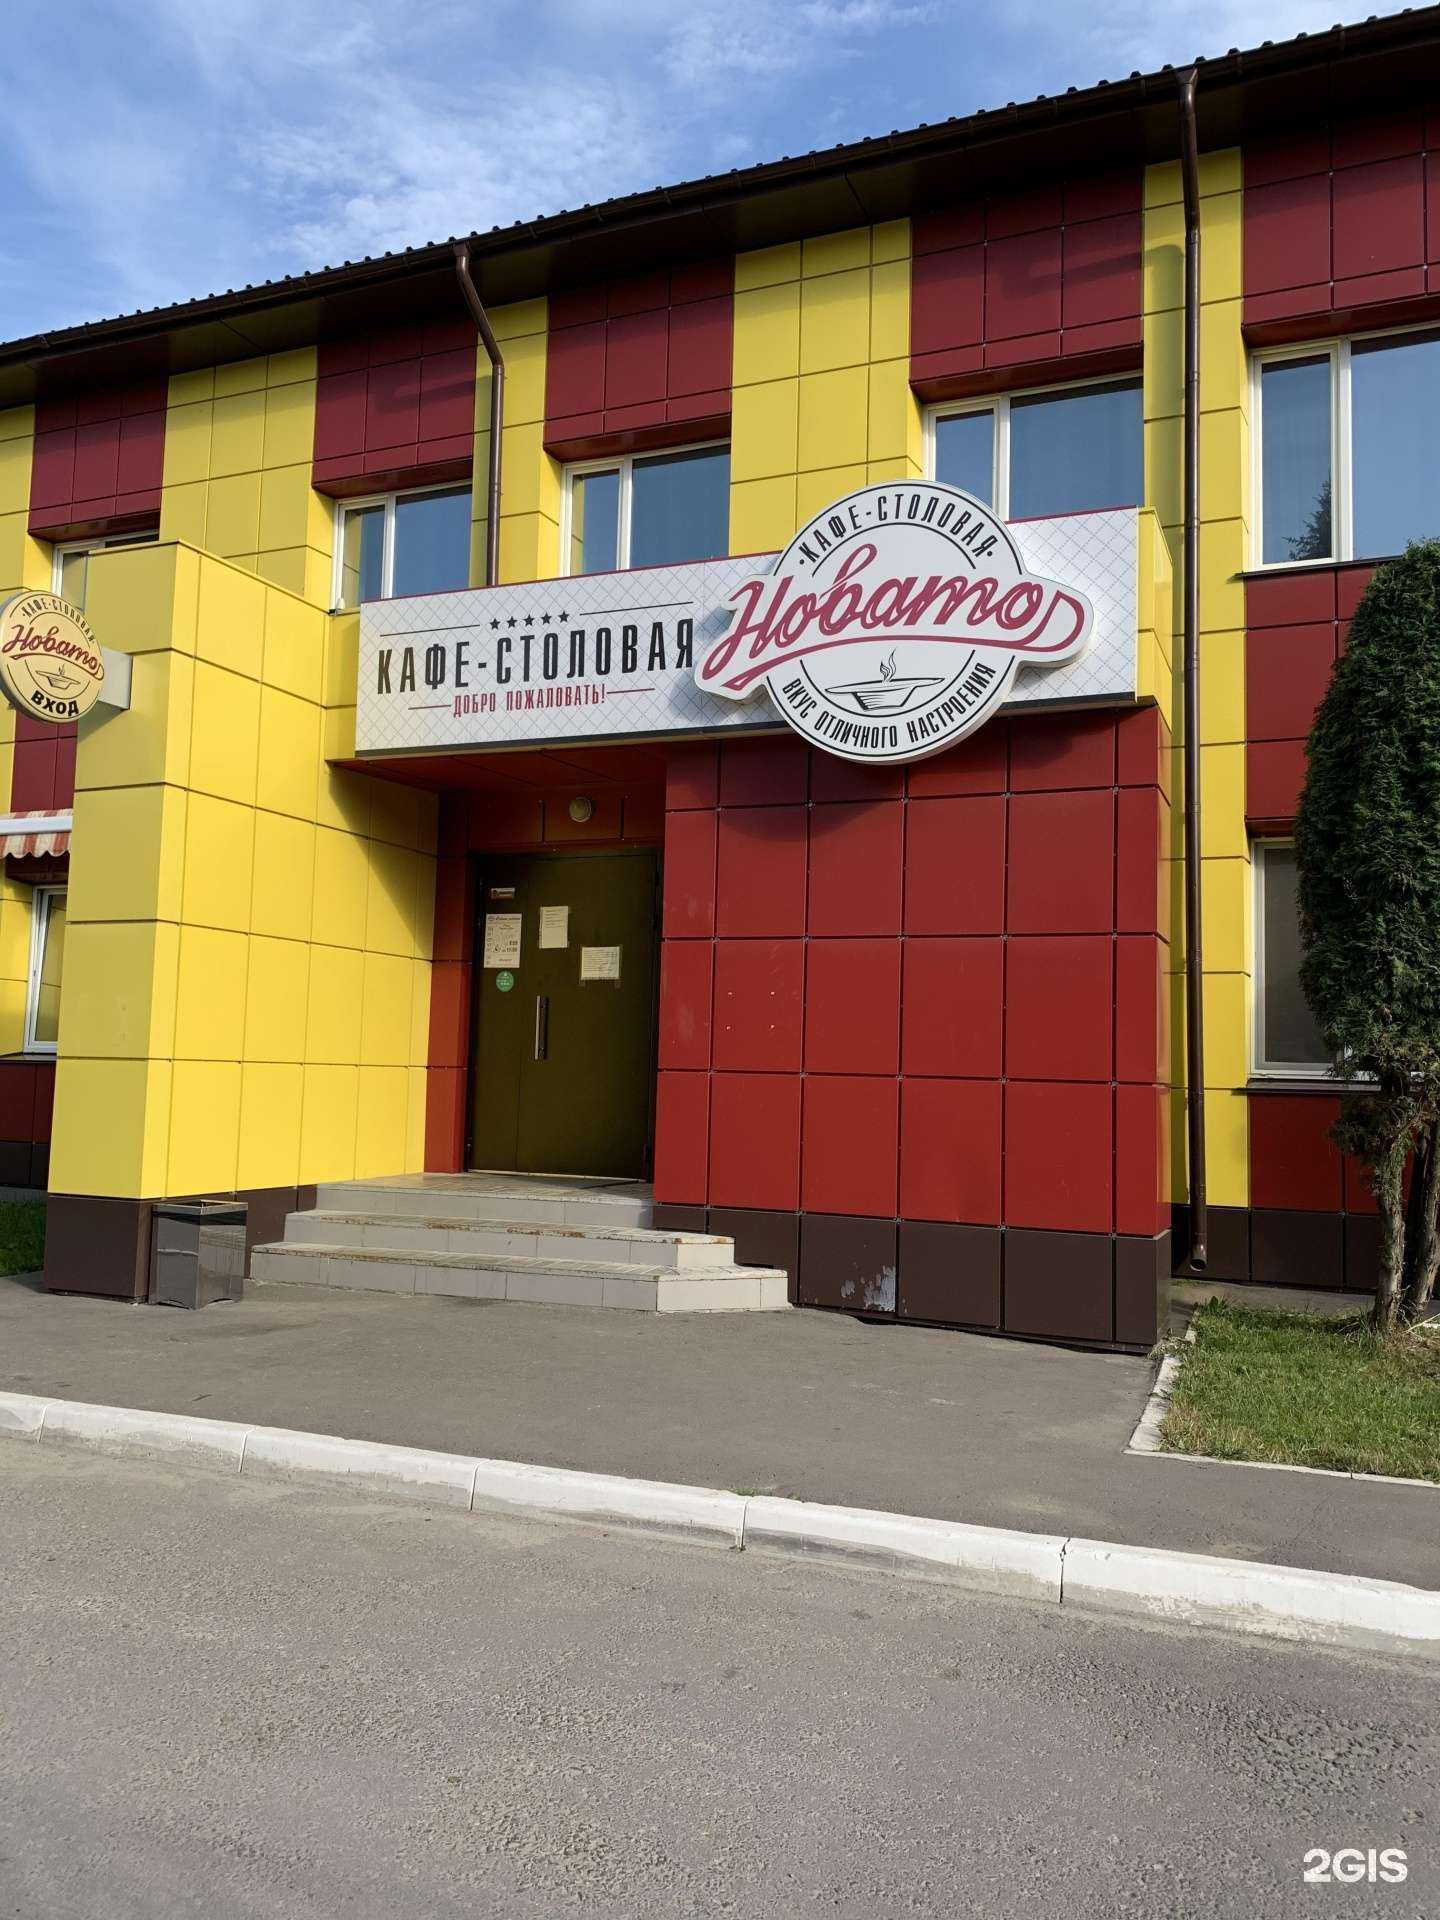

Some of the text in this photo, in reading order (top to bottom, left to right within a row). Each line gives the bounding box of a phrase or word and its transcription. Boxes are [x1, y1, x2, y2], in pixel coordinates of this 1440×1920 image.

[800, 494, 998, 563] КАФЕ-СТОЛОВАЯ
[377, 618, 694, 694] КАФЕ-СТОЛОВАЯ
[31, 690, 79, 717] ВХОД
[454, 684, 606, 718] ДОБРО ПОЖАЛОВАТЬ!
[782, 662, 997, 749] ВКУС ОТЛИЧНОГО НАСТРОЕНИЯ
